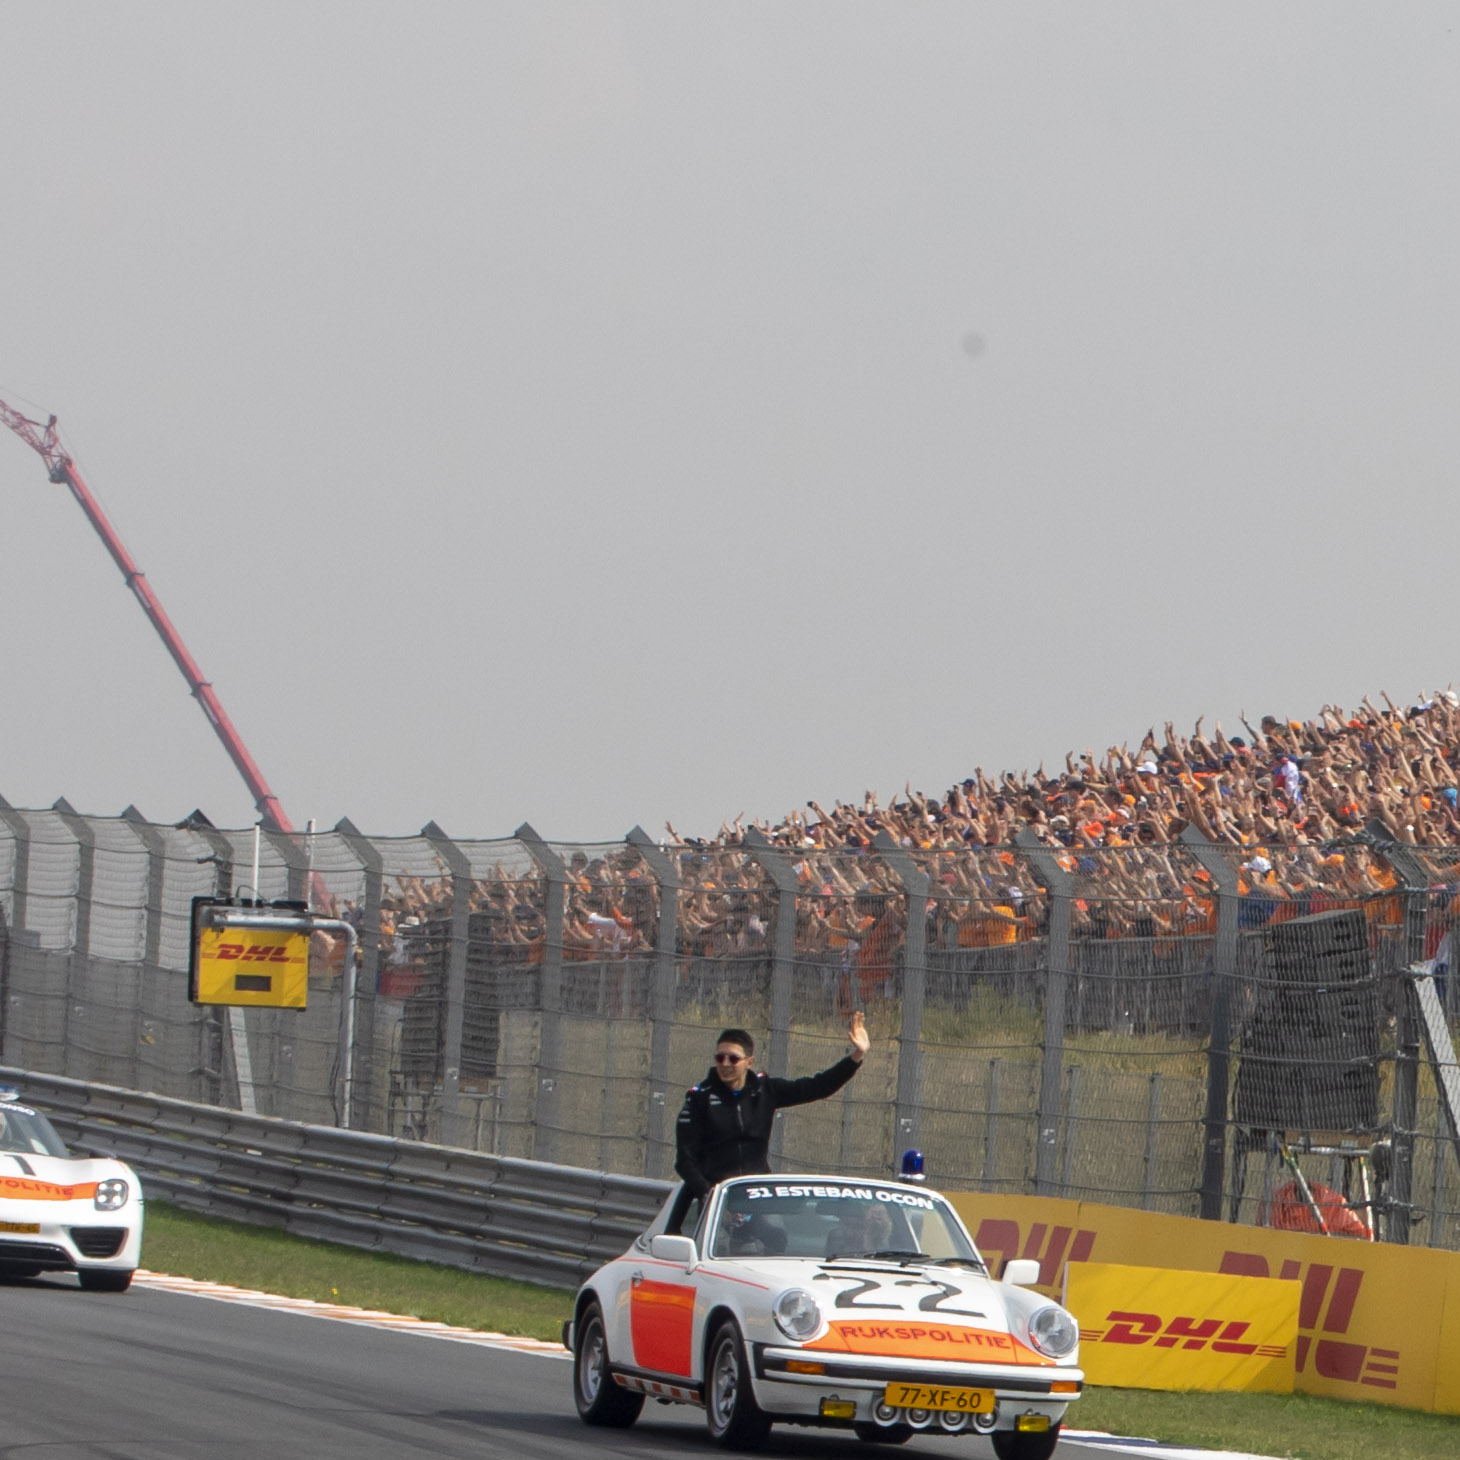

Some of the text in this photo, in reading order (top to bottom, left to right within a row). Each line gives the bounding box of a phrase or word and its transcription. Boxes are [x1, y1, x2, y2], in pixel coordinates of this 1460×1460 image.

[217, 944, 290, 963] DHL
[746, 1186, 934, 1210] 31 ESTEBAN OCON
[812, 1272, 988, 1319] 22
[841, 1326, 1012, 1349] RIJKSPOLITIE
[1101, 1311, 1256, 1356] DHL
[899, 1386, 982, 1409] 77-XF-60
